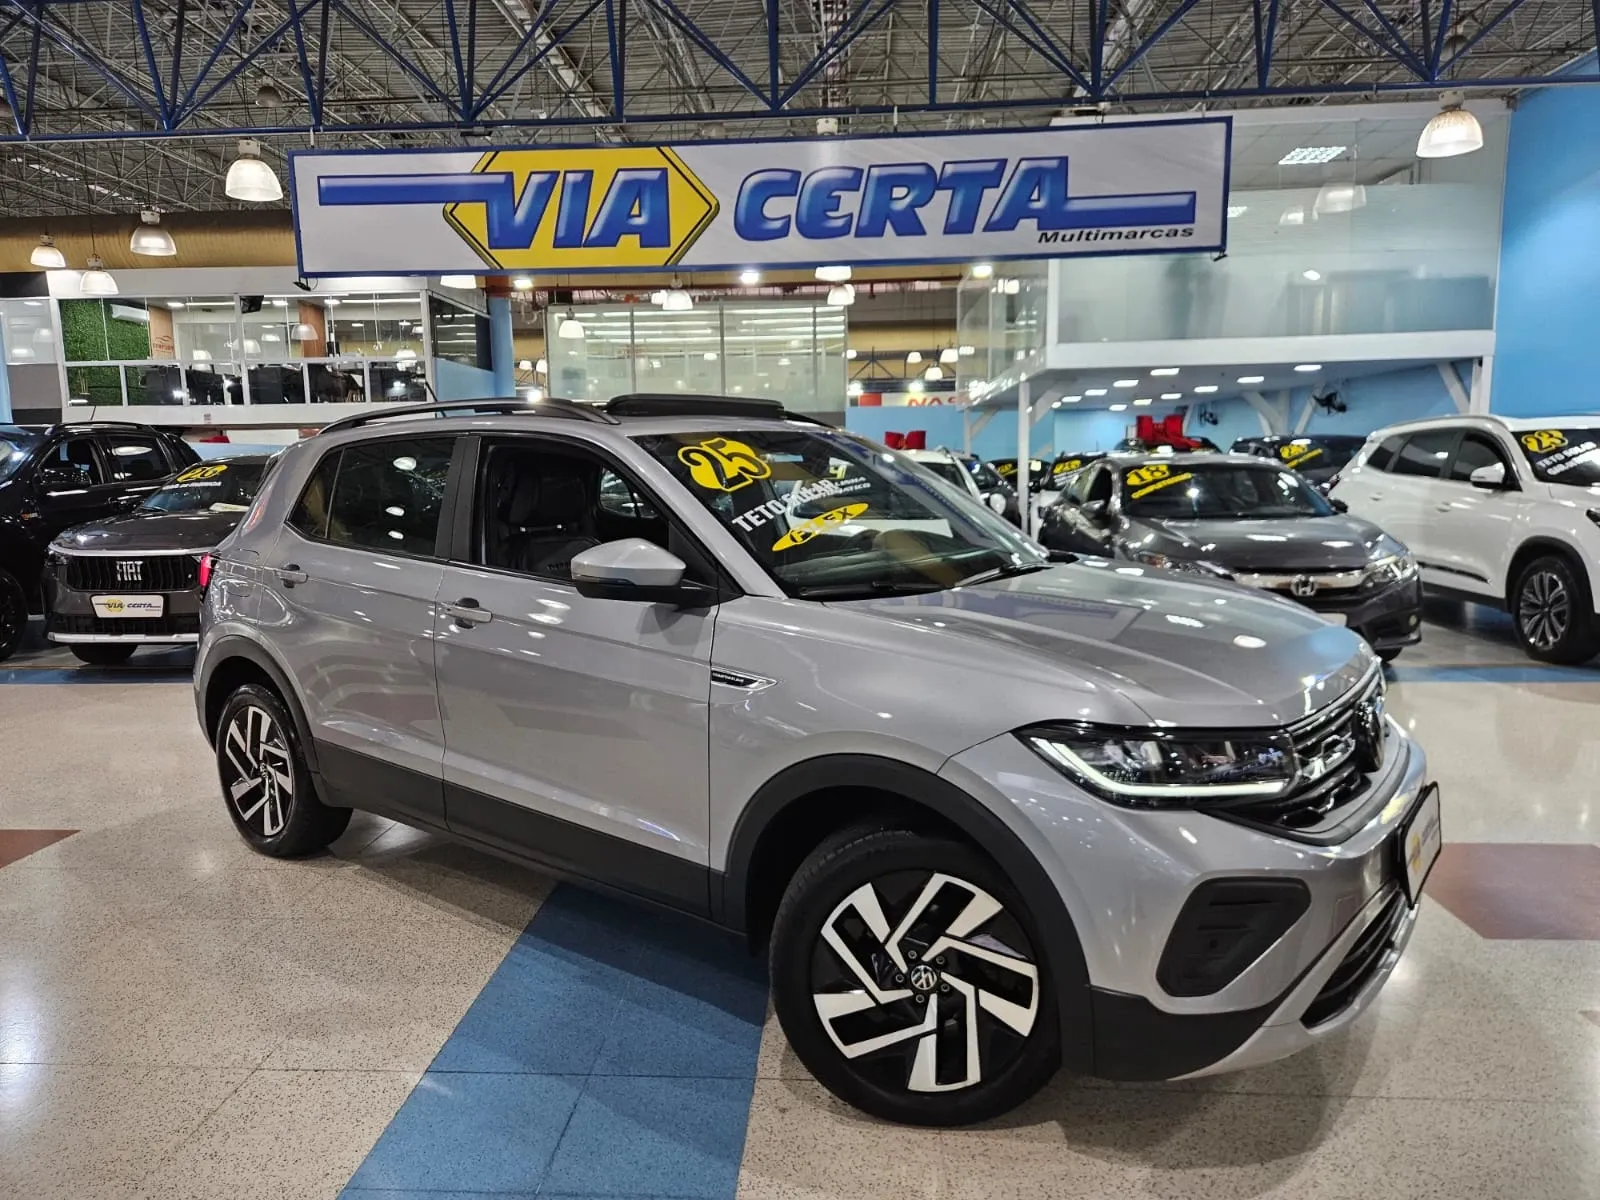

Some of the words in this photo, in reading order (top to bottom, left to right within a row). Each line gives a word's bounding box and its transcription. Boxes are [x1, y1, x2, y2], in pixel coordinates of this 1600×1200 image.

[485, 167, 672, 250] VIA
[733, 156, 1069, 242] CERTA
[1037, 226, 1195, 244] Multimarcas
[678, 438, 771, 491] 25
[1127, 465, 1169, 486] 18
[731, 498, 788, 532] TETO
[116, 560, 143, 581] FIAT
